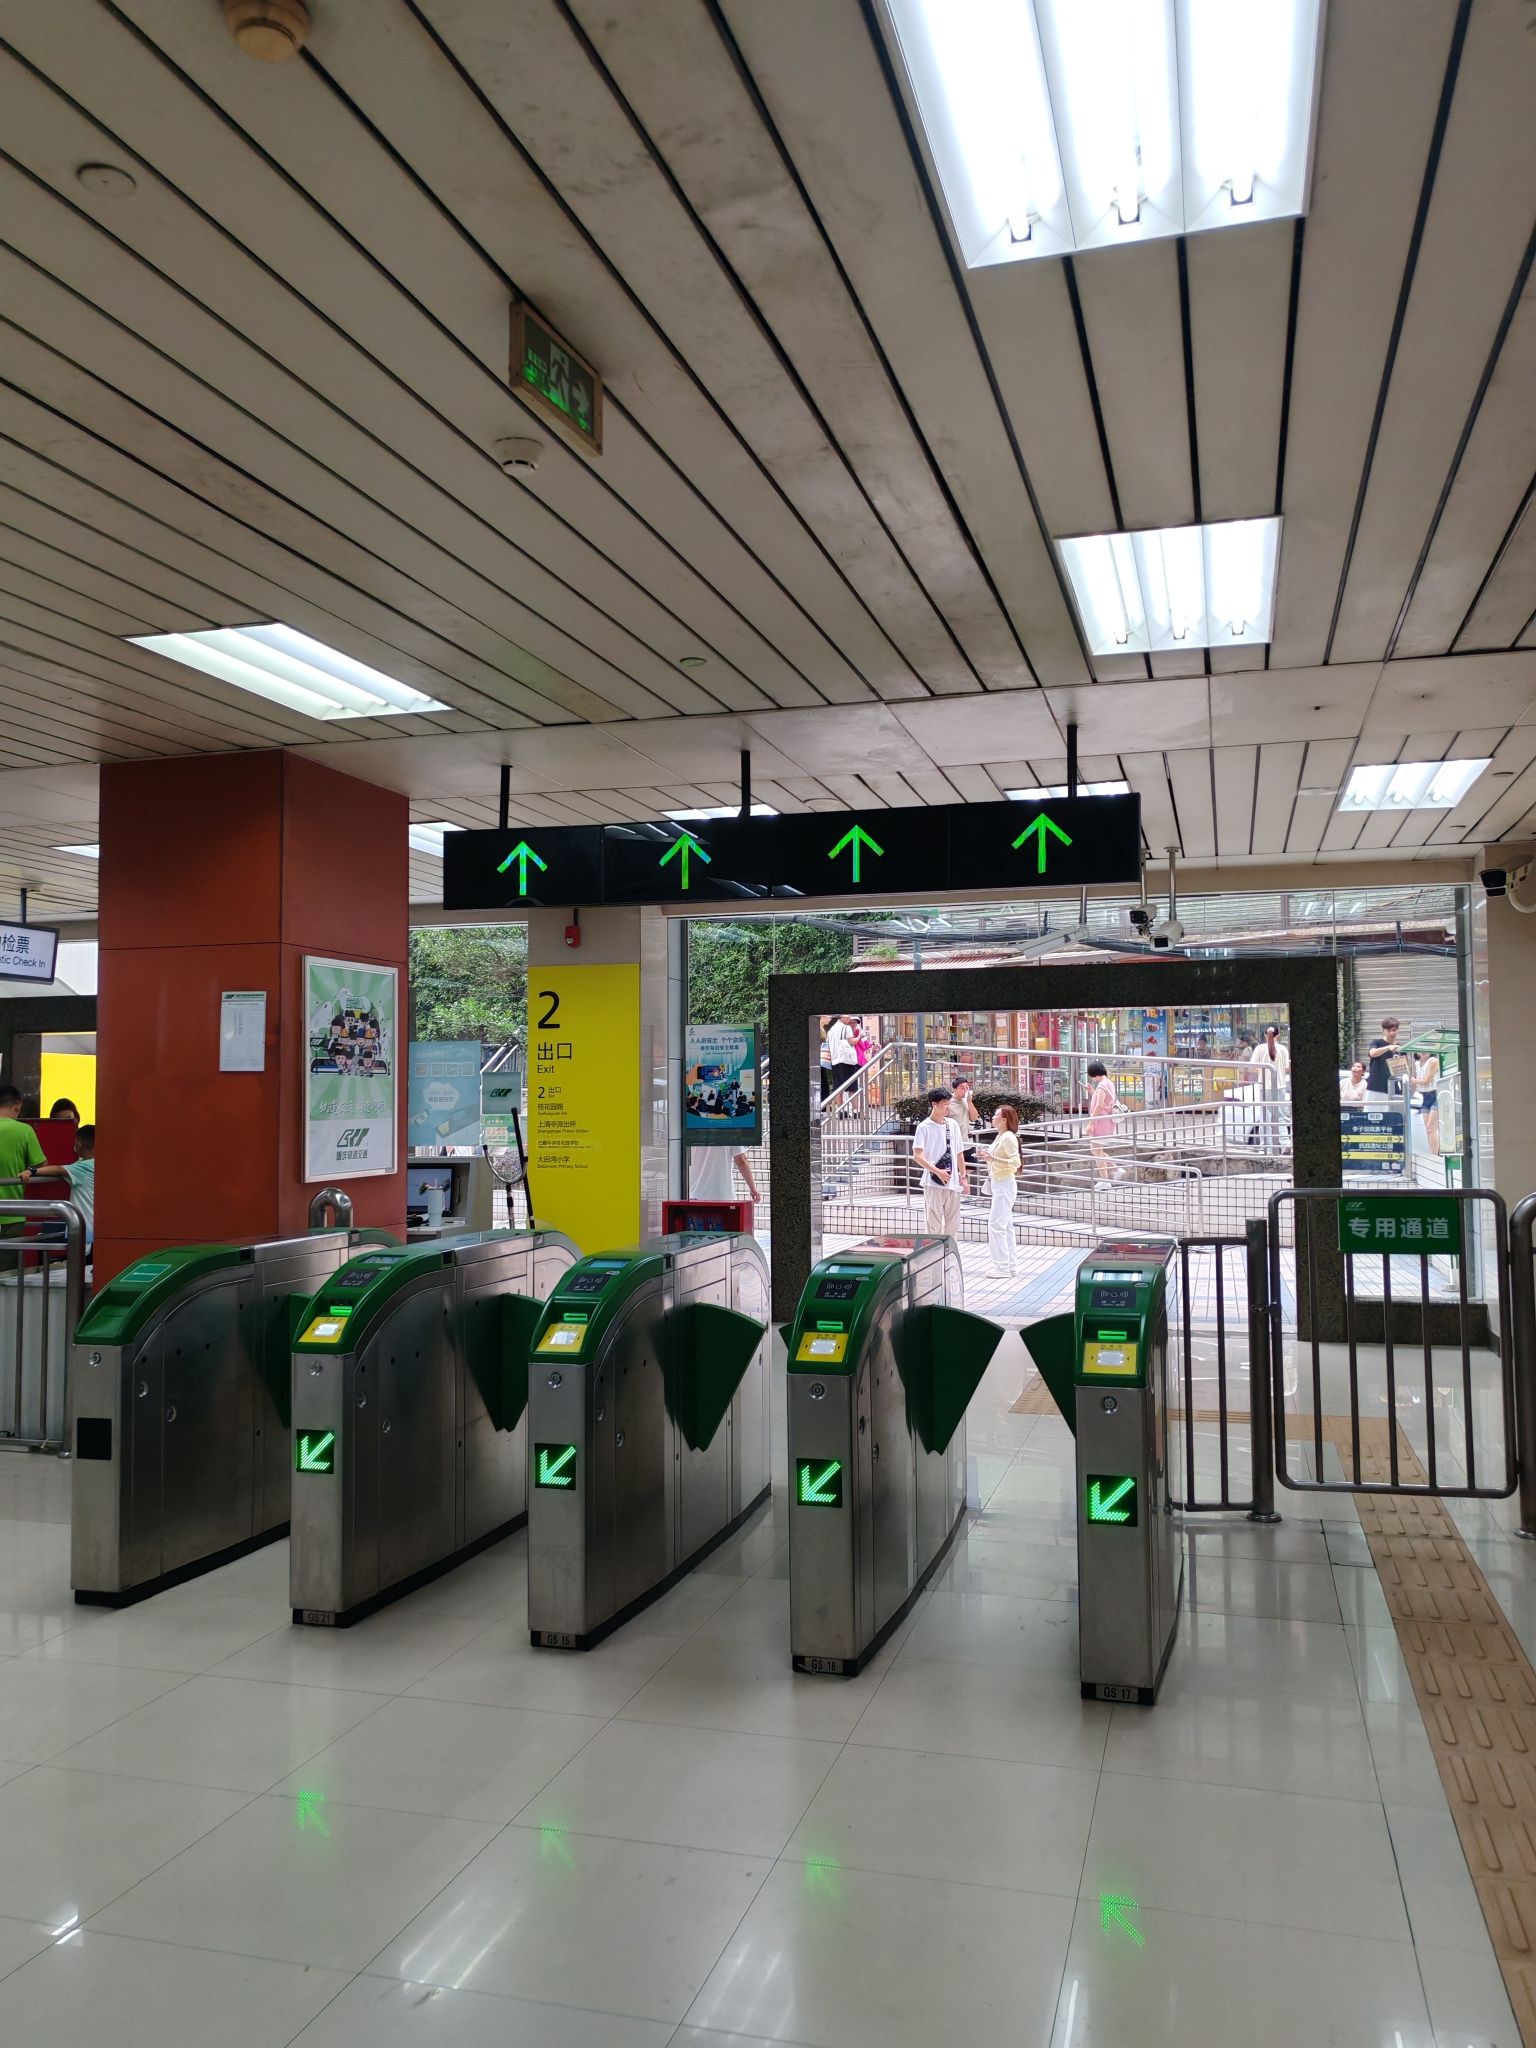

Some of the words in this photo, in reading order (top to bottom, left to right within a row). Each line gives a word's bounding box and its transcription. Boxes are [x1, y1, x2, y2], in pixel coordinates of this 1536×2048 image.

[0, 933, 30, 954] 检票
[13, 956, 37, 968] Check
[38, 960, 46, 968] In
[538, 991, 560, 1029] 2
[537, 1042, 572, 1061] 出口
[537, 1065, 555, 1074] Exit
[537, 1086, 545, 1099] 2
[1348, 1217, 1449, 1239] 专用通道
[547, 1633, 558, 1645] GS
[811, 1659, 823, 1670] GS
[1104, 1686, 1117, 1698] GS
